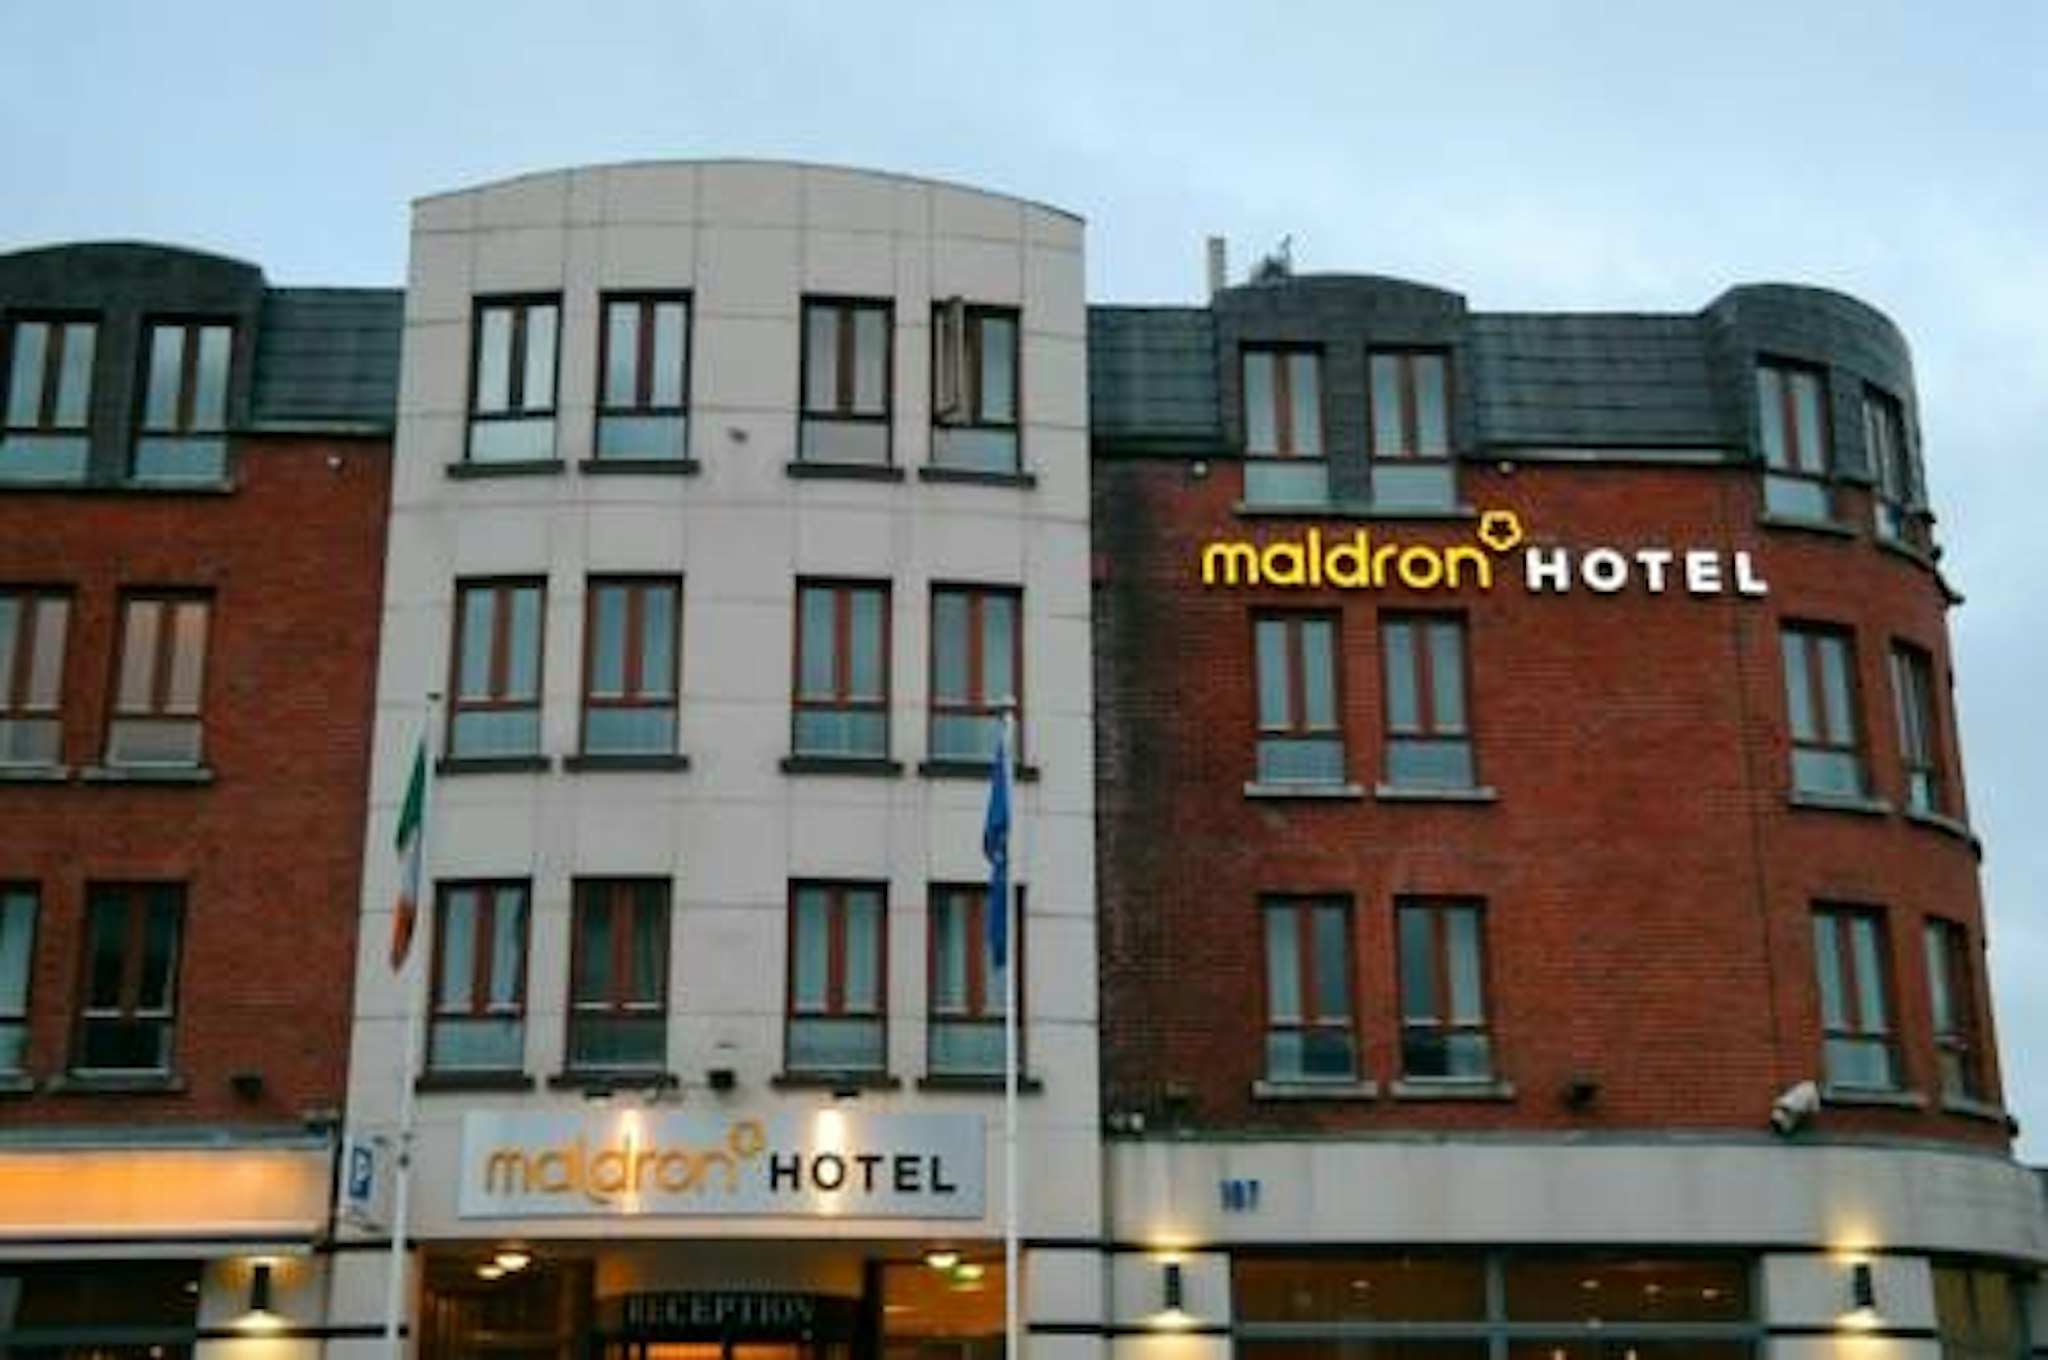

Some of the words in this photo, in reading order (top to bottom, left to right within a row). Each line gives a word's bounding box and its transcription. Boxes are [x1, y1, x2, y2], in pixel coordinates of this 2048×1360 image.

[1201, 527, 1492, 588] maldron
[1526, 546, 1768, 595] HOTEL
[485, 1133, 741, 1199] maldron
[769, 1153, 957, 1194] HOTEL
